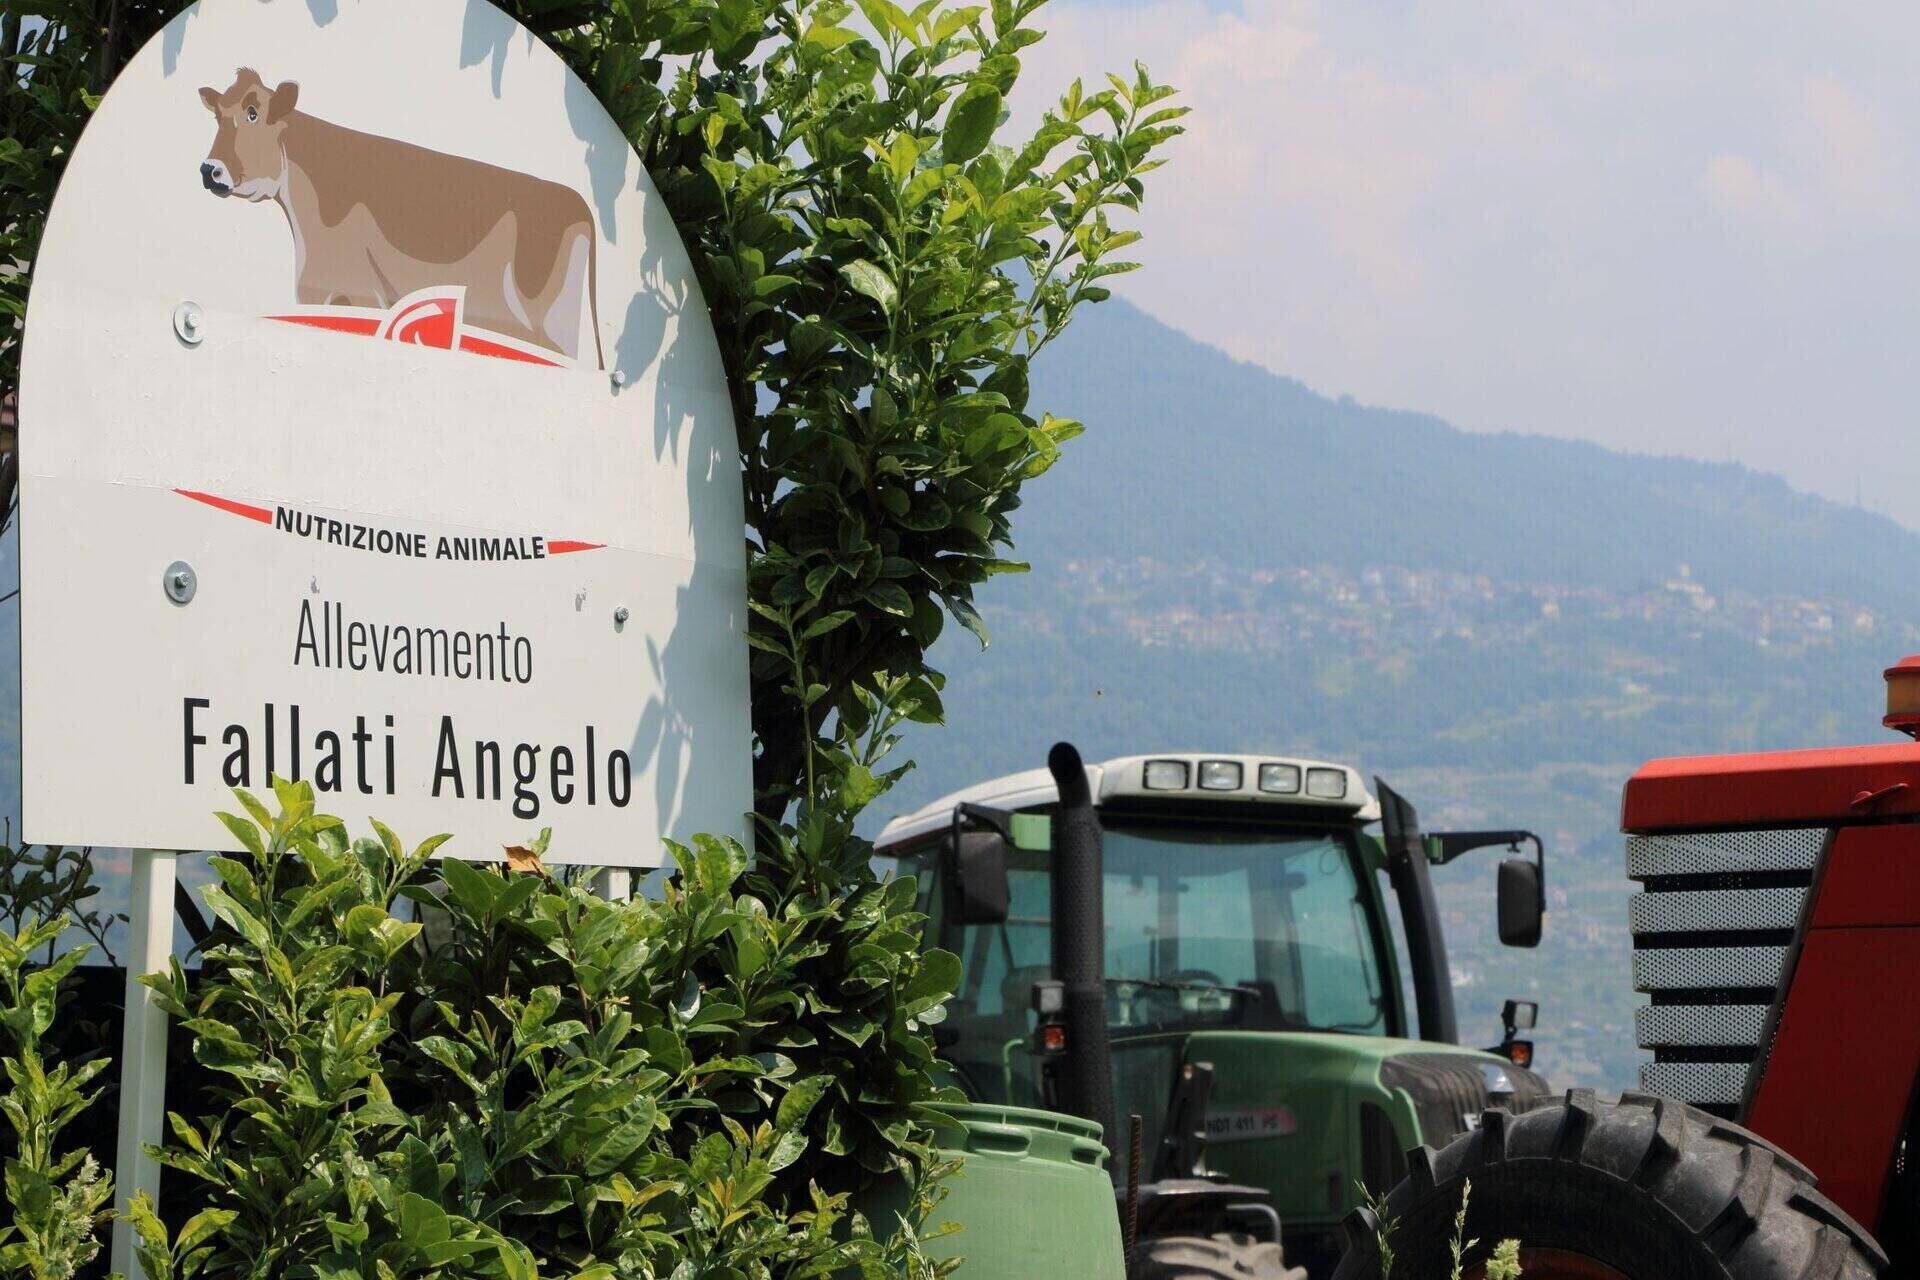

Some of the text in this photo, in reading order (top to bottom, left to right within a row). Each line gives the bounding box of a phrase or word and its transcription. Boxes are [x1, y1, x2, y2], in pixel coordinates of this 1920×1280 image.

[276, 506, 545, 561] NUTRIZIONE ANIMALE
[294, 599, 532, 684] Allevamento
[184, 697, 631, 819] Fallati Angelo
